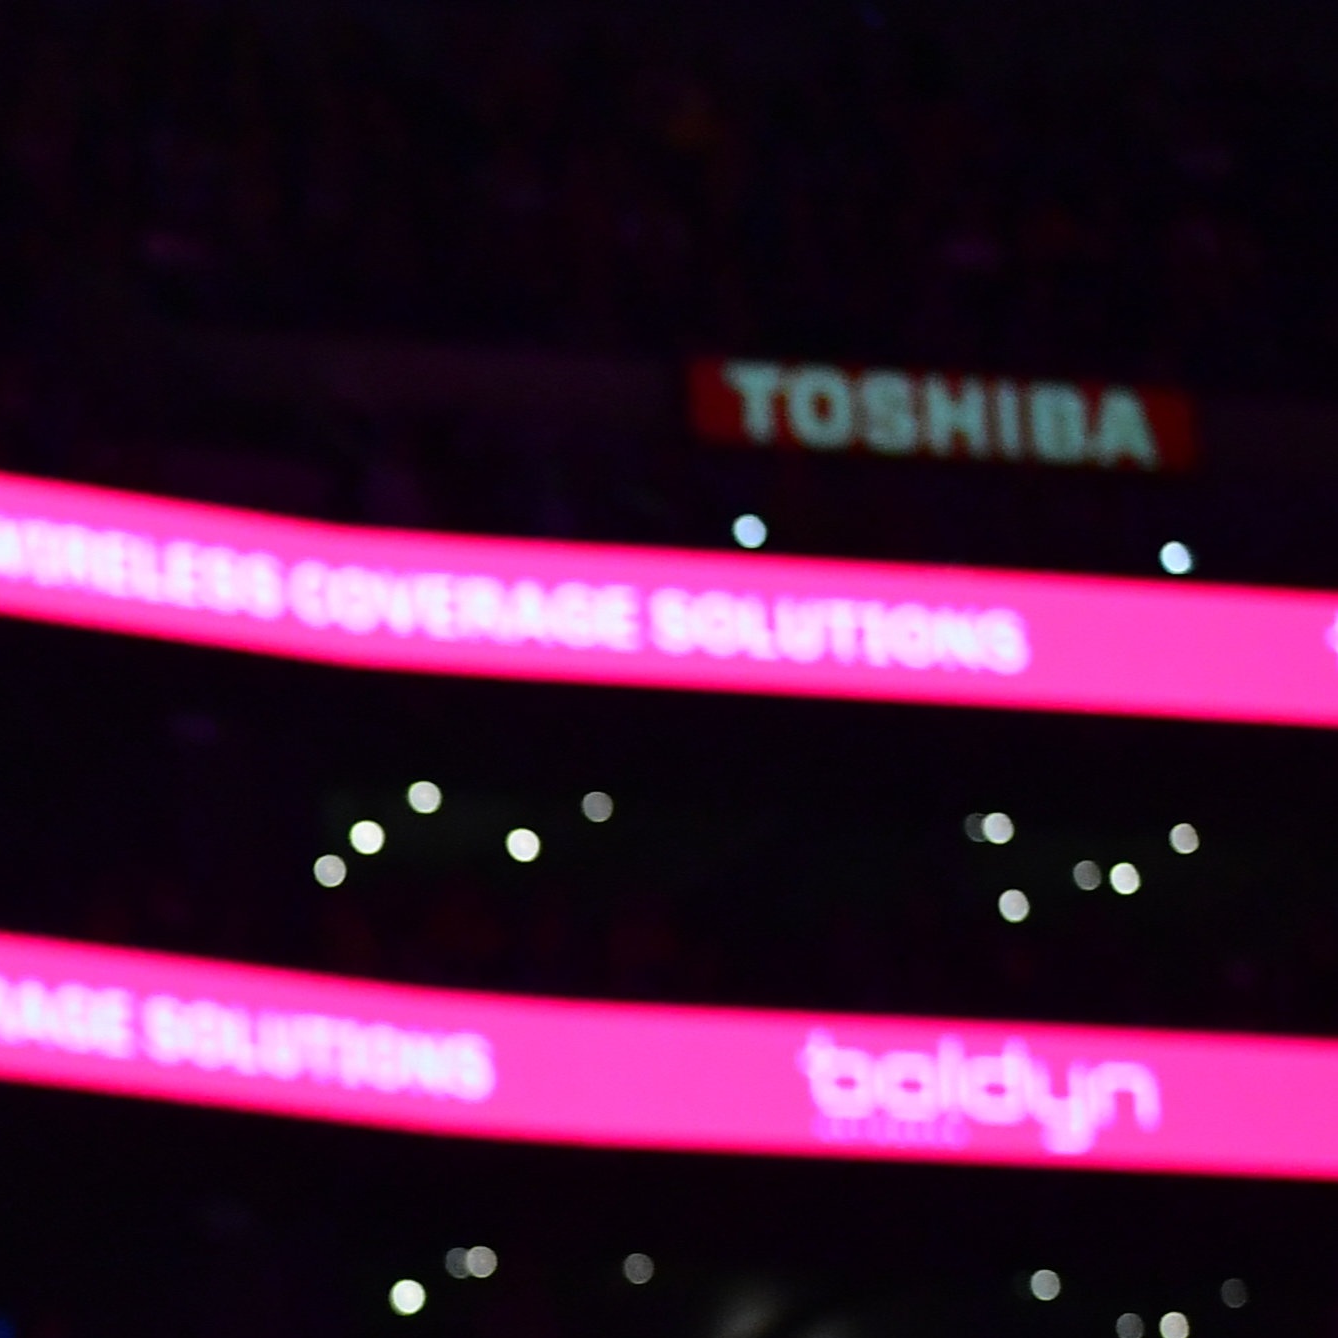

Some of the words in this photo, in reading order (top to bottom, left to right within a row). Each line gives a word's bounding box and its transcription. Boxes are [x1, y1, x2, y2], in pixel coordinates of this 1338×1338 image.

[723, 360, 1162, 470] TOSHIBA
[288, 558, 643, 654] COVERAGE
[648, 585, 1032, 676] SOLUTIONS
[139, 993, 497, 1104] SOLUTIONS
[794, 1024, 1163, 1156] boldyn
